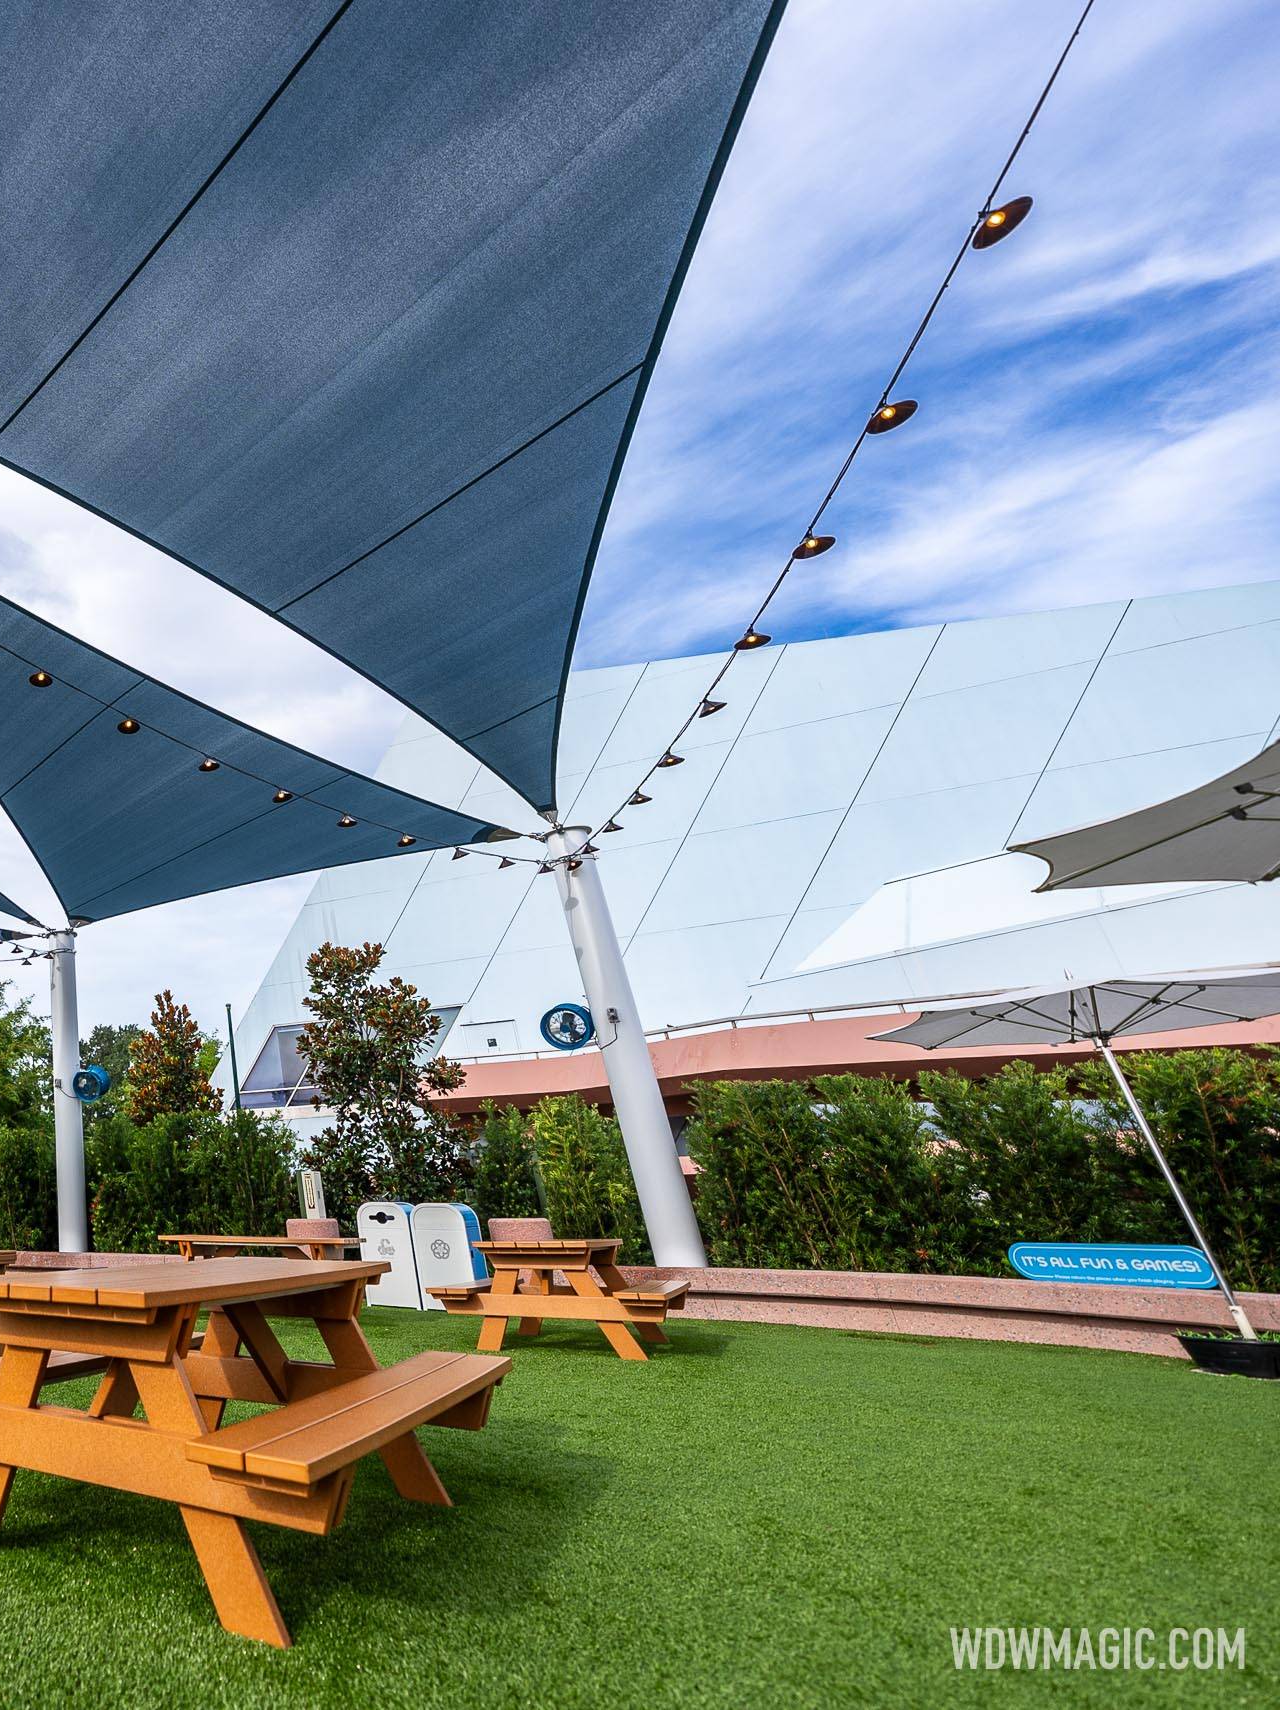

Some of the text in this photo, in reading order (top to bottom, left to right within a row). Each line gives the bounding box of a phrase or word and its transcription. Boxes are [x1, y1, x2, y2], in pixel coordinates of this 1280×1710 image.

[1021, 1255, 1202, 1273] IT'S ALL FUN & GAMES!
